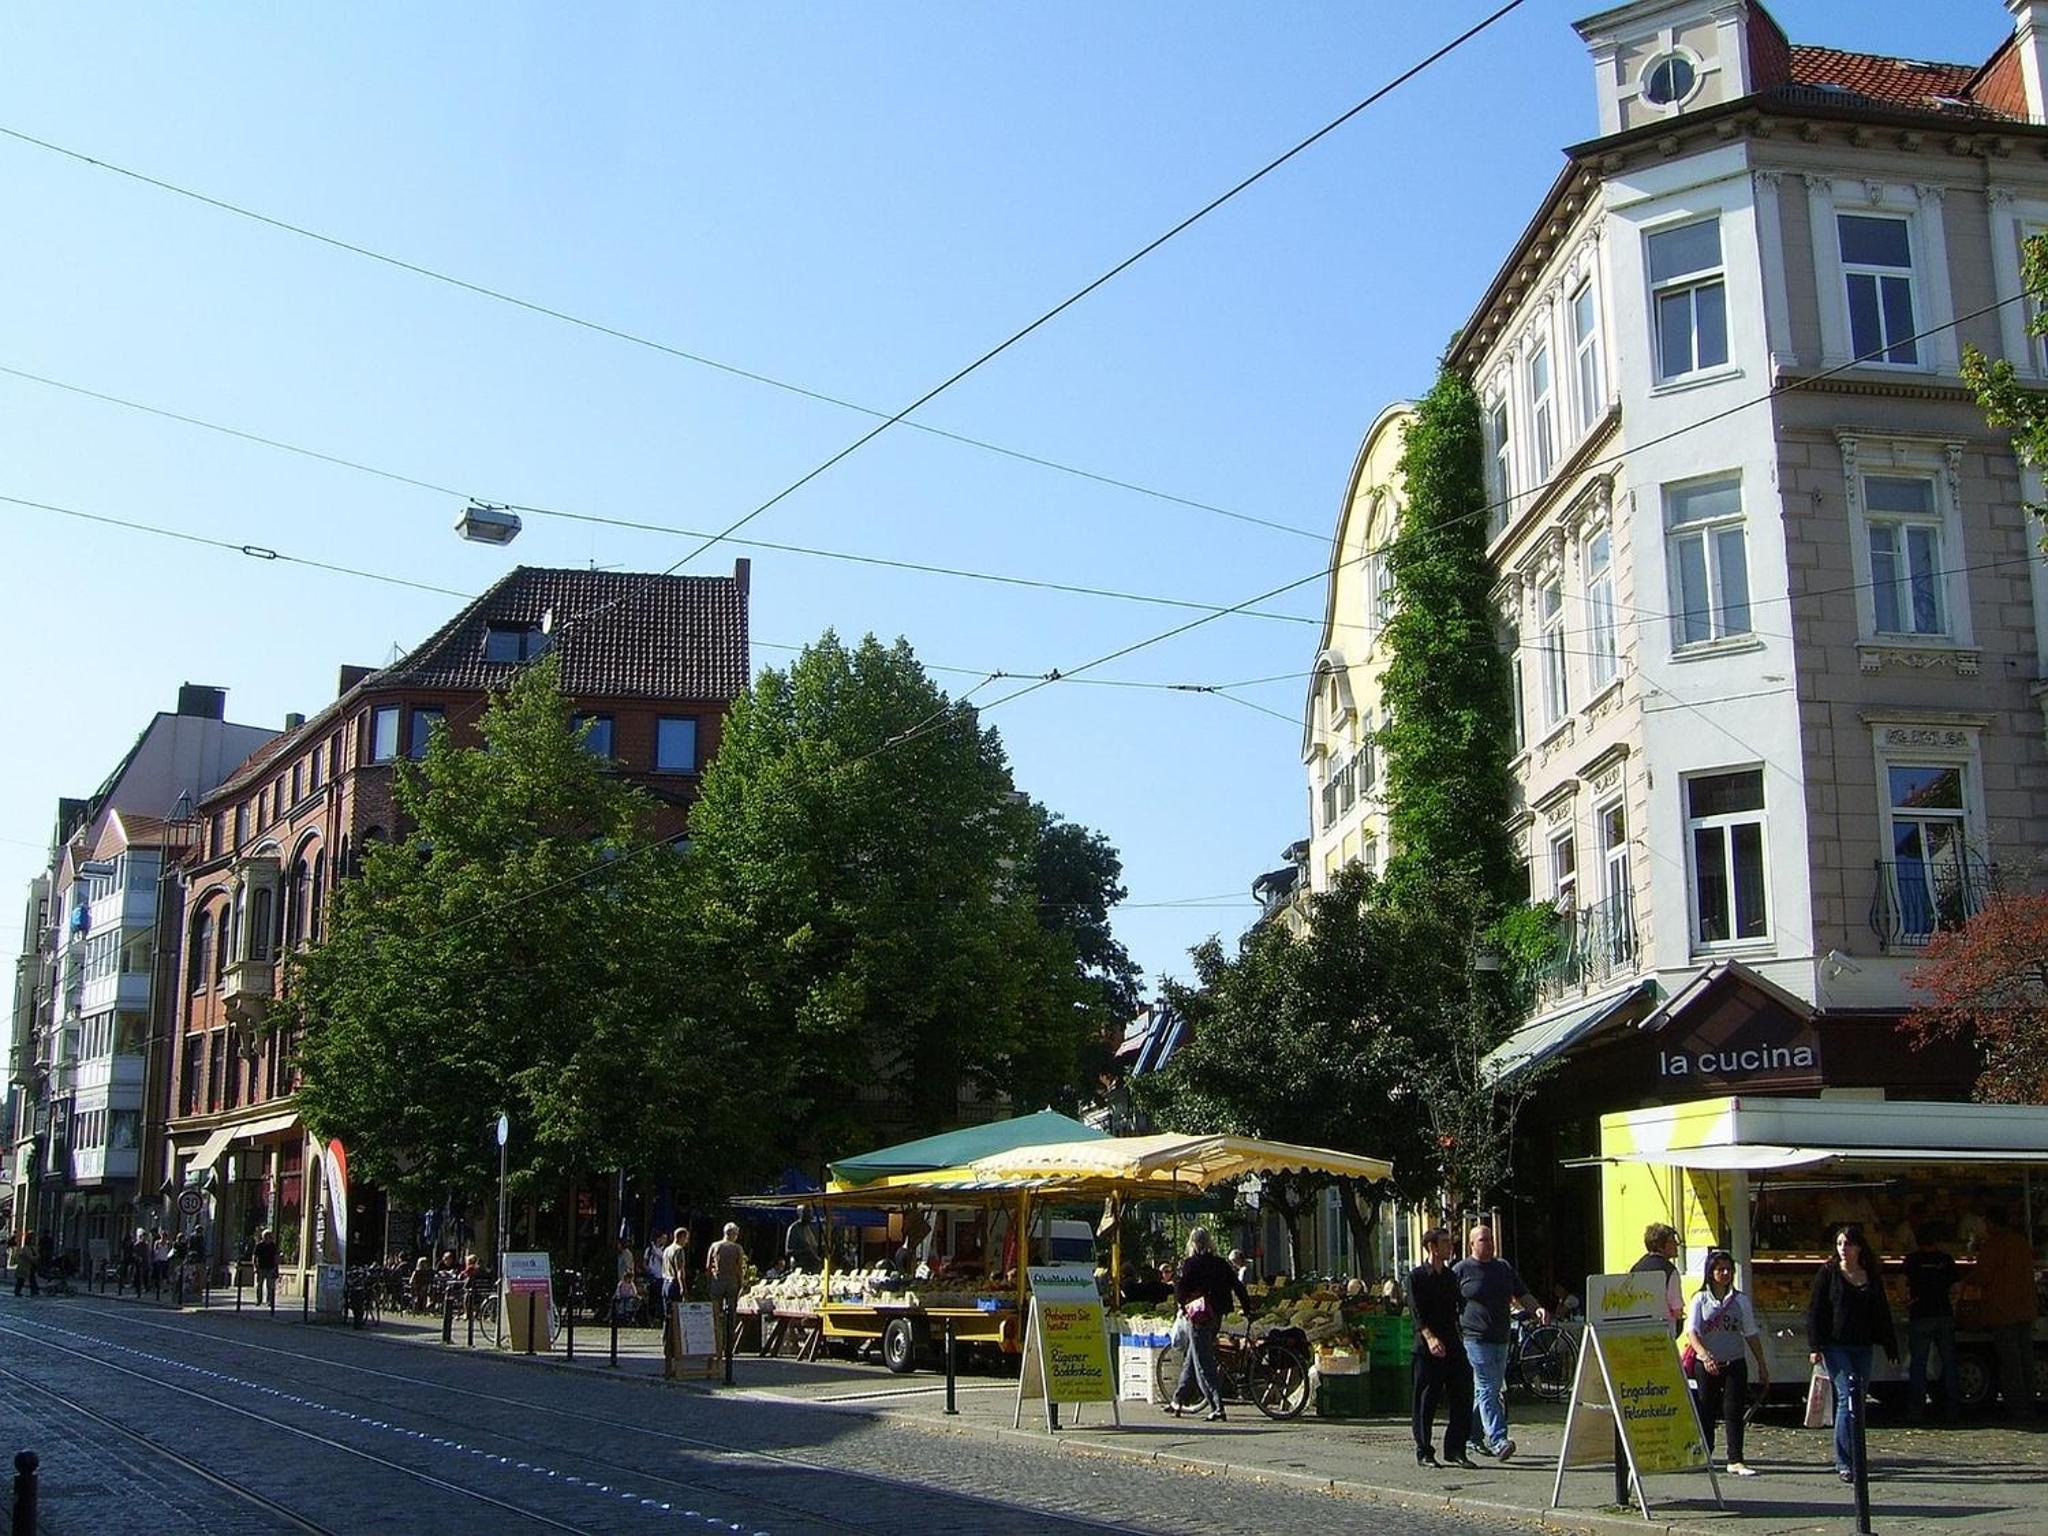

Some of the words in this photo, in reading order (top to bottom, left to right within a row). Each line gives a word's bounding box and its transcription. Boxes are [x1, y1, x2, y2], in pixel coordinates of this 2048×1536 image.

[1660, 1051, 1688, 1075] la
[1698, 1043, 1813, 1073] cucina
[184, 1196, 199, 1209] 30
[1620, 1380, 1670, 1404] Engadiner
[1624, 1404, 1678, 1420] Felsenkeller
